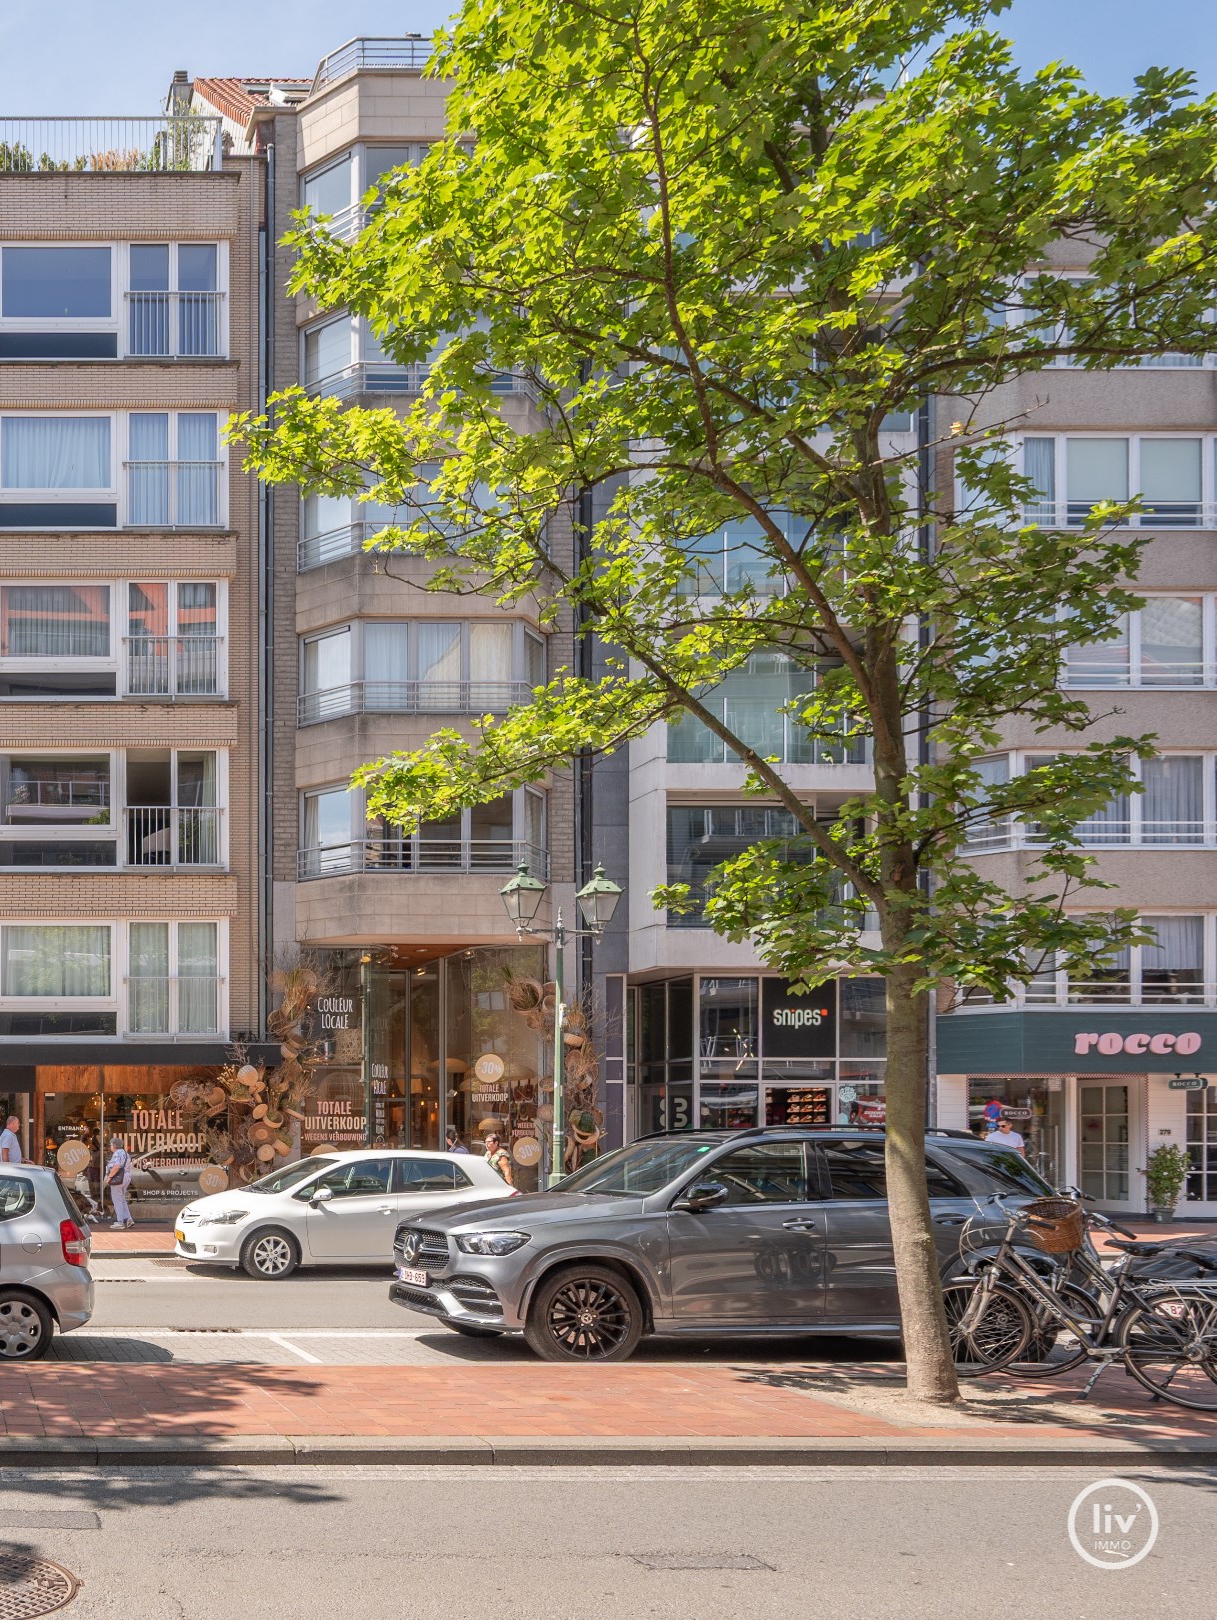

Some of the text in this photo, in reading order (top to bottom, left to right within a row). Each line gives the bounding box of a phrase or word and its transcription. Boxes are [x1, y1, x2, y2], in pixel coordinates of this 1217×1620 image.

[317, 997, 353, 1012] COULEUR
[321, 1014, 349, 1029] LOCALE
[773, 1009, 821, 1029] snipes
[1075, 1032, 1202, 1055] rocco
[478, 1062, 502, 1074] -30%
[479, 1083, 499, 1092] TOTALE
[472, 1094, 509, 1102] UITVERKOOP
[317, 1101, 352, 1115] TOTALE
[131, 1109, 184, 1130] TOTALE
[304, 1116, 367, 1130] UITVERKOOP
[304, 1133, 367, 1141] WEGENS VERBOUWING
[61, 1147, 88, 1167] -30%
[150, 1158, 206, 1169] VERBOUWING
